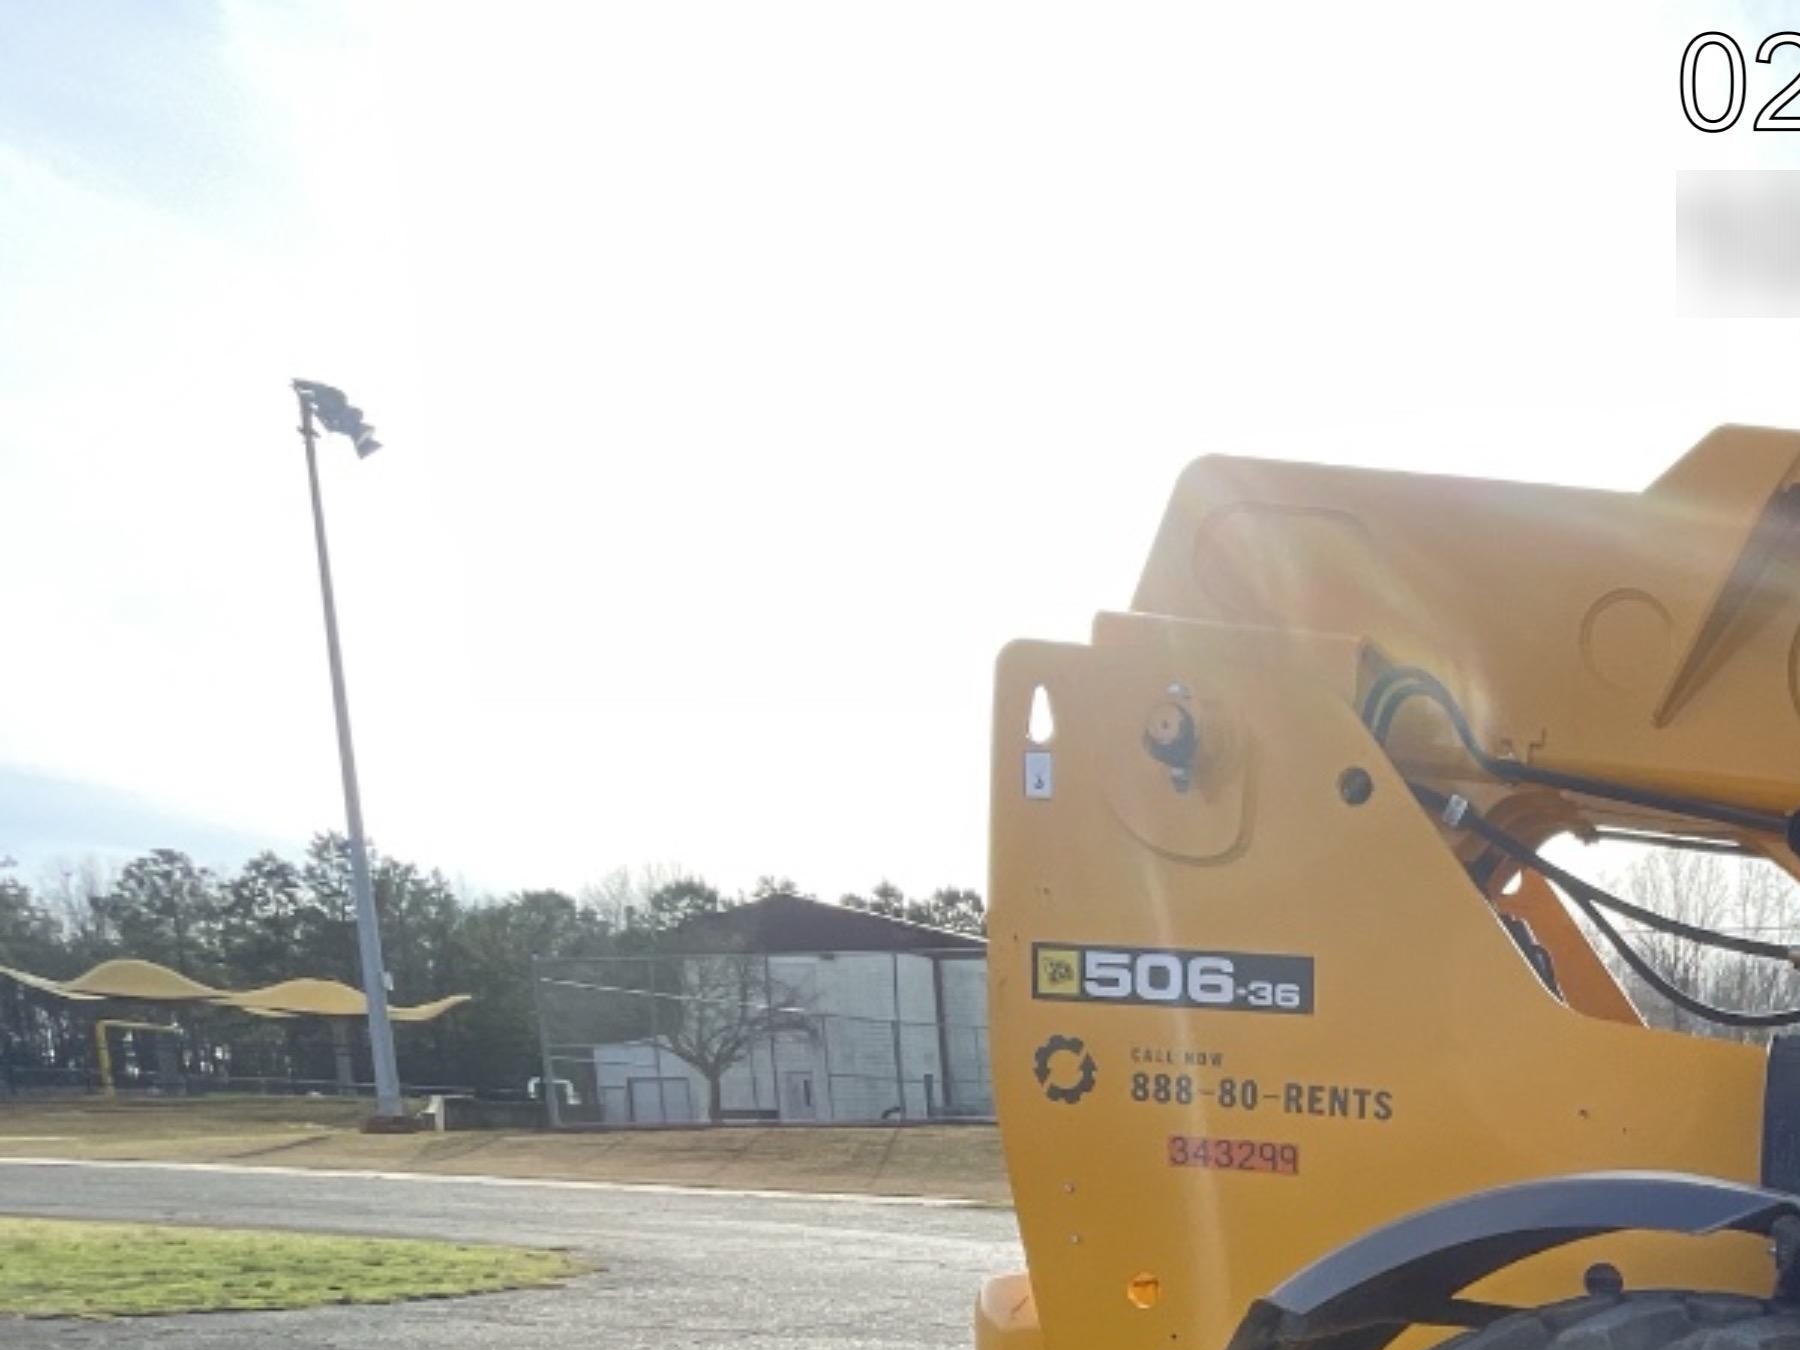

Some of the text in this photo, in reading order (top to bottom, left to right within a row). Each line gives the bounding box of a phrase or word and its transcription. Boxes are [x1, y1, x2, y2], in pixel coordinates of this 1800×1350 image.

[1084, 952, 1300, 1006] 506-36
[1131, 1048, 1223, 1066] CALL NOW
[1131, 1073, 1393, 1121] 888-80-RENTS
[1168, 1136, 1299, 1174] 343299
